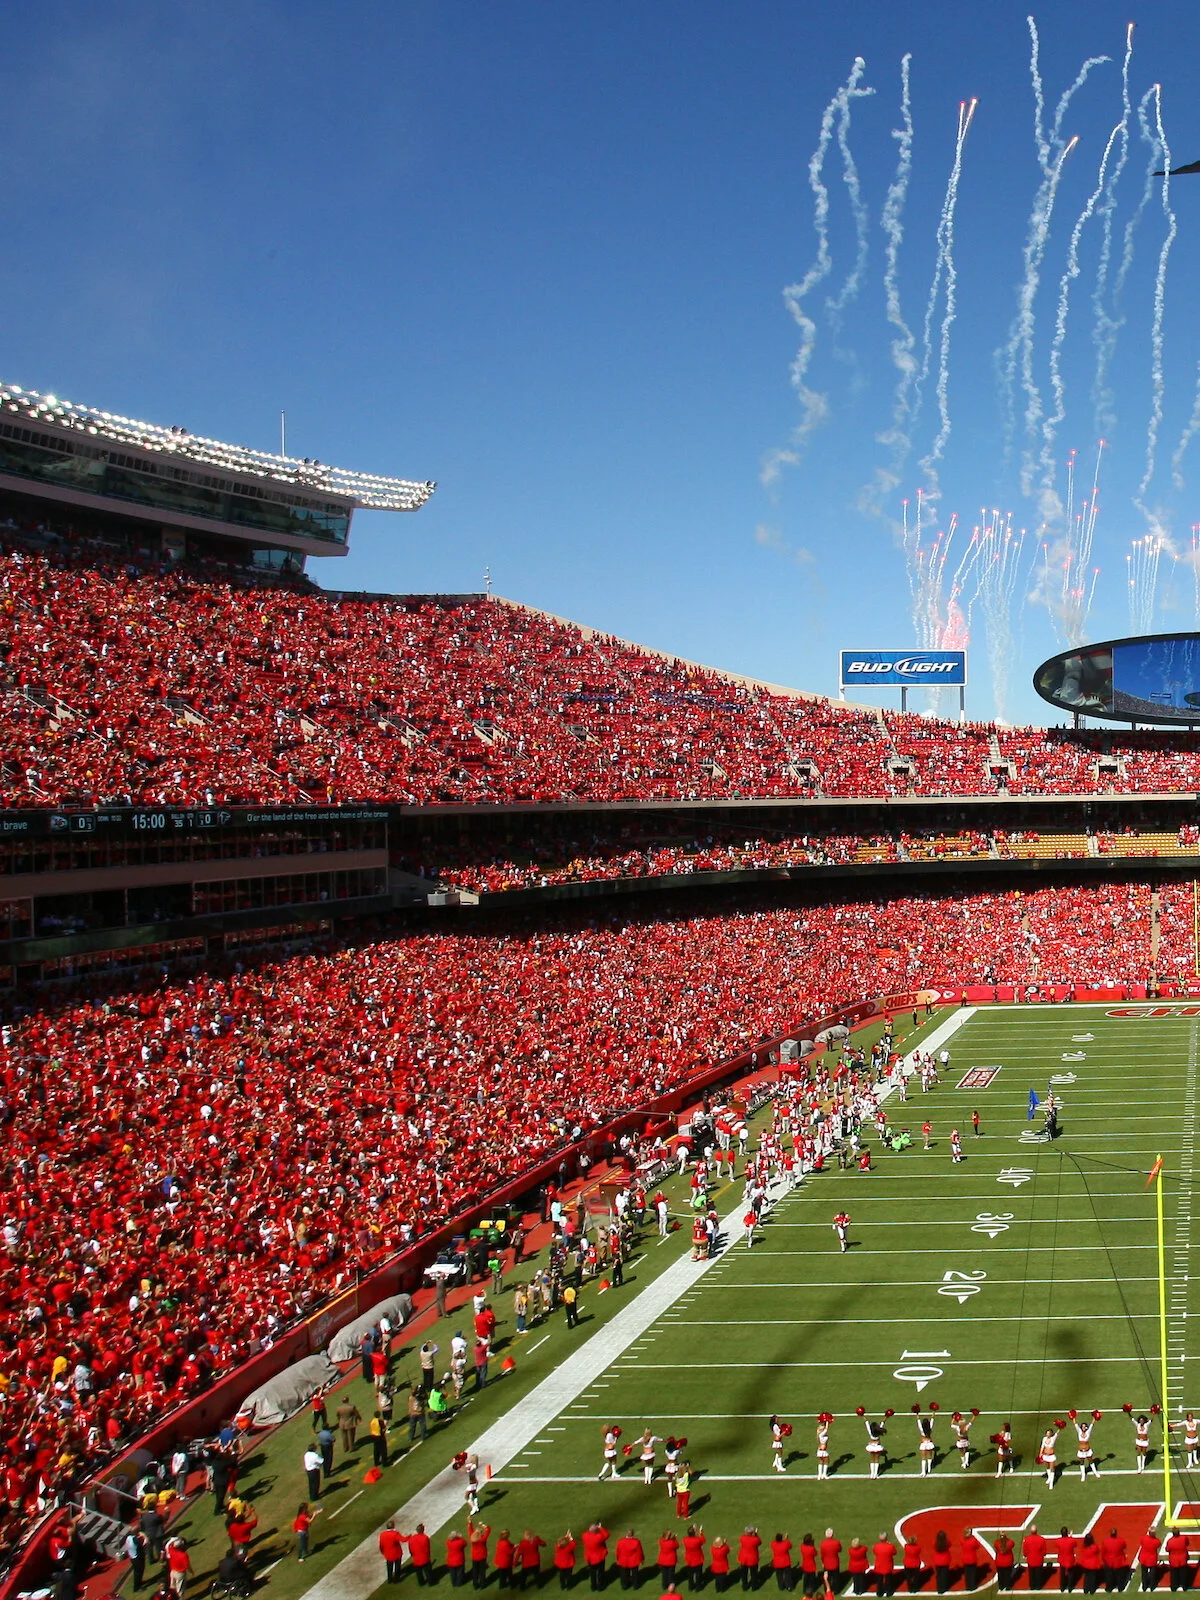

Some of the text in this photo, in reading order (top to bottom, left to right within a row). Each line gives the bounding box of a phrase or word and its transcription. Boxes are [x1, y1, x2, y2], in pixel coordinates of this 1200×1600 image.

[848, 662, 958, 673] BUD LIGHT
[4, 821, 27, 830] brave
[79, 818, 85, 829] 0
[132, 813, 165, 829] 15:00
[175, 819, 183, 828] 35
[205, 814, 211, 824] 0
[886, 993, 918, 1008] CHIEFS
[996, 1167, 1034, 1183] 40
[971, 1212, 1015, 1232] 30
[937, 1270, 987, 1296] 20
[893, 1349, 951, 1381] 10
